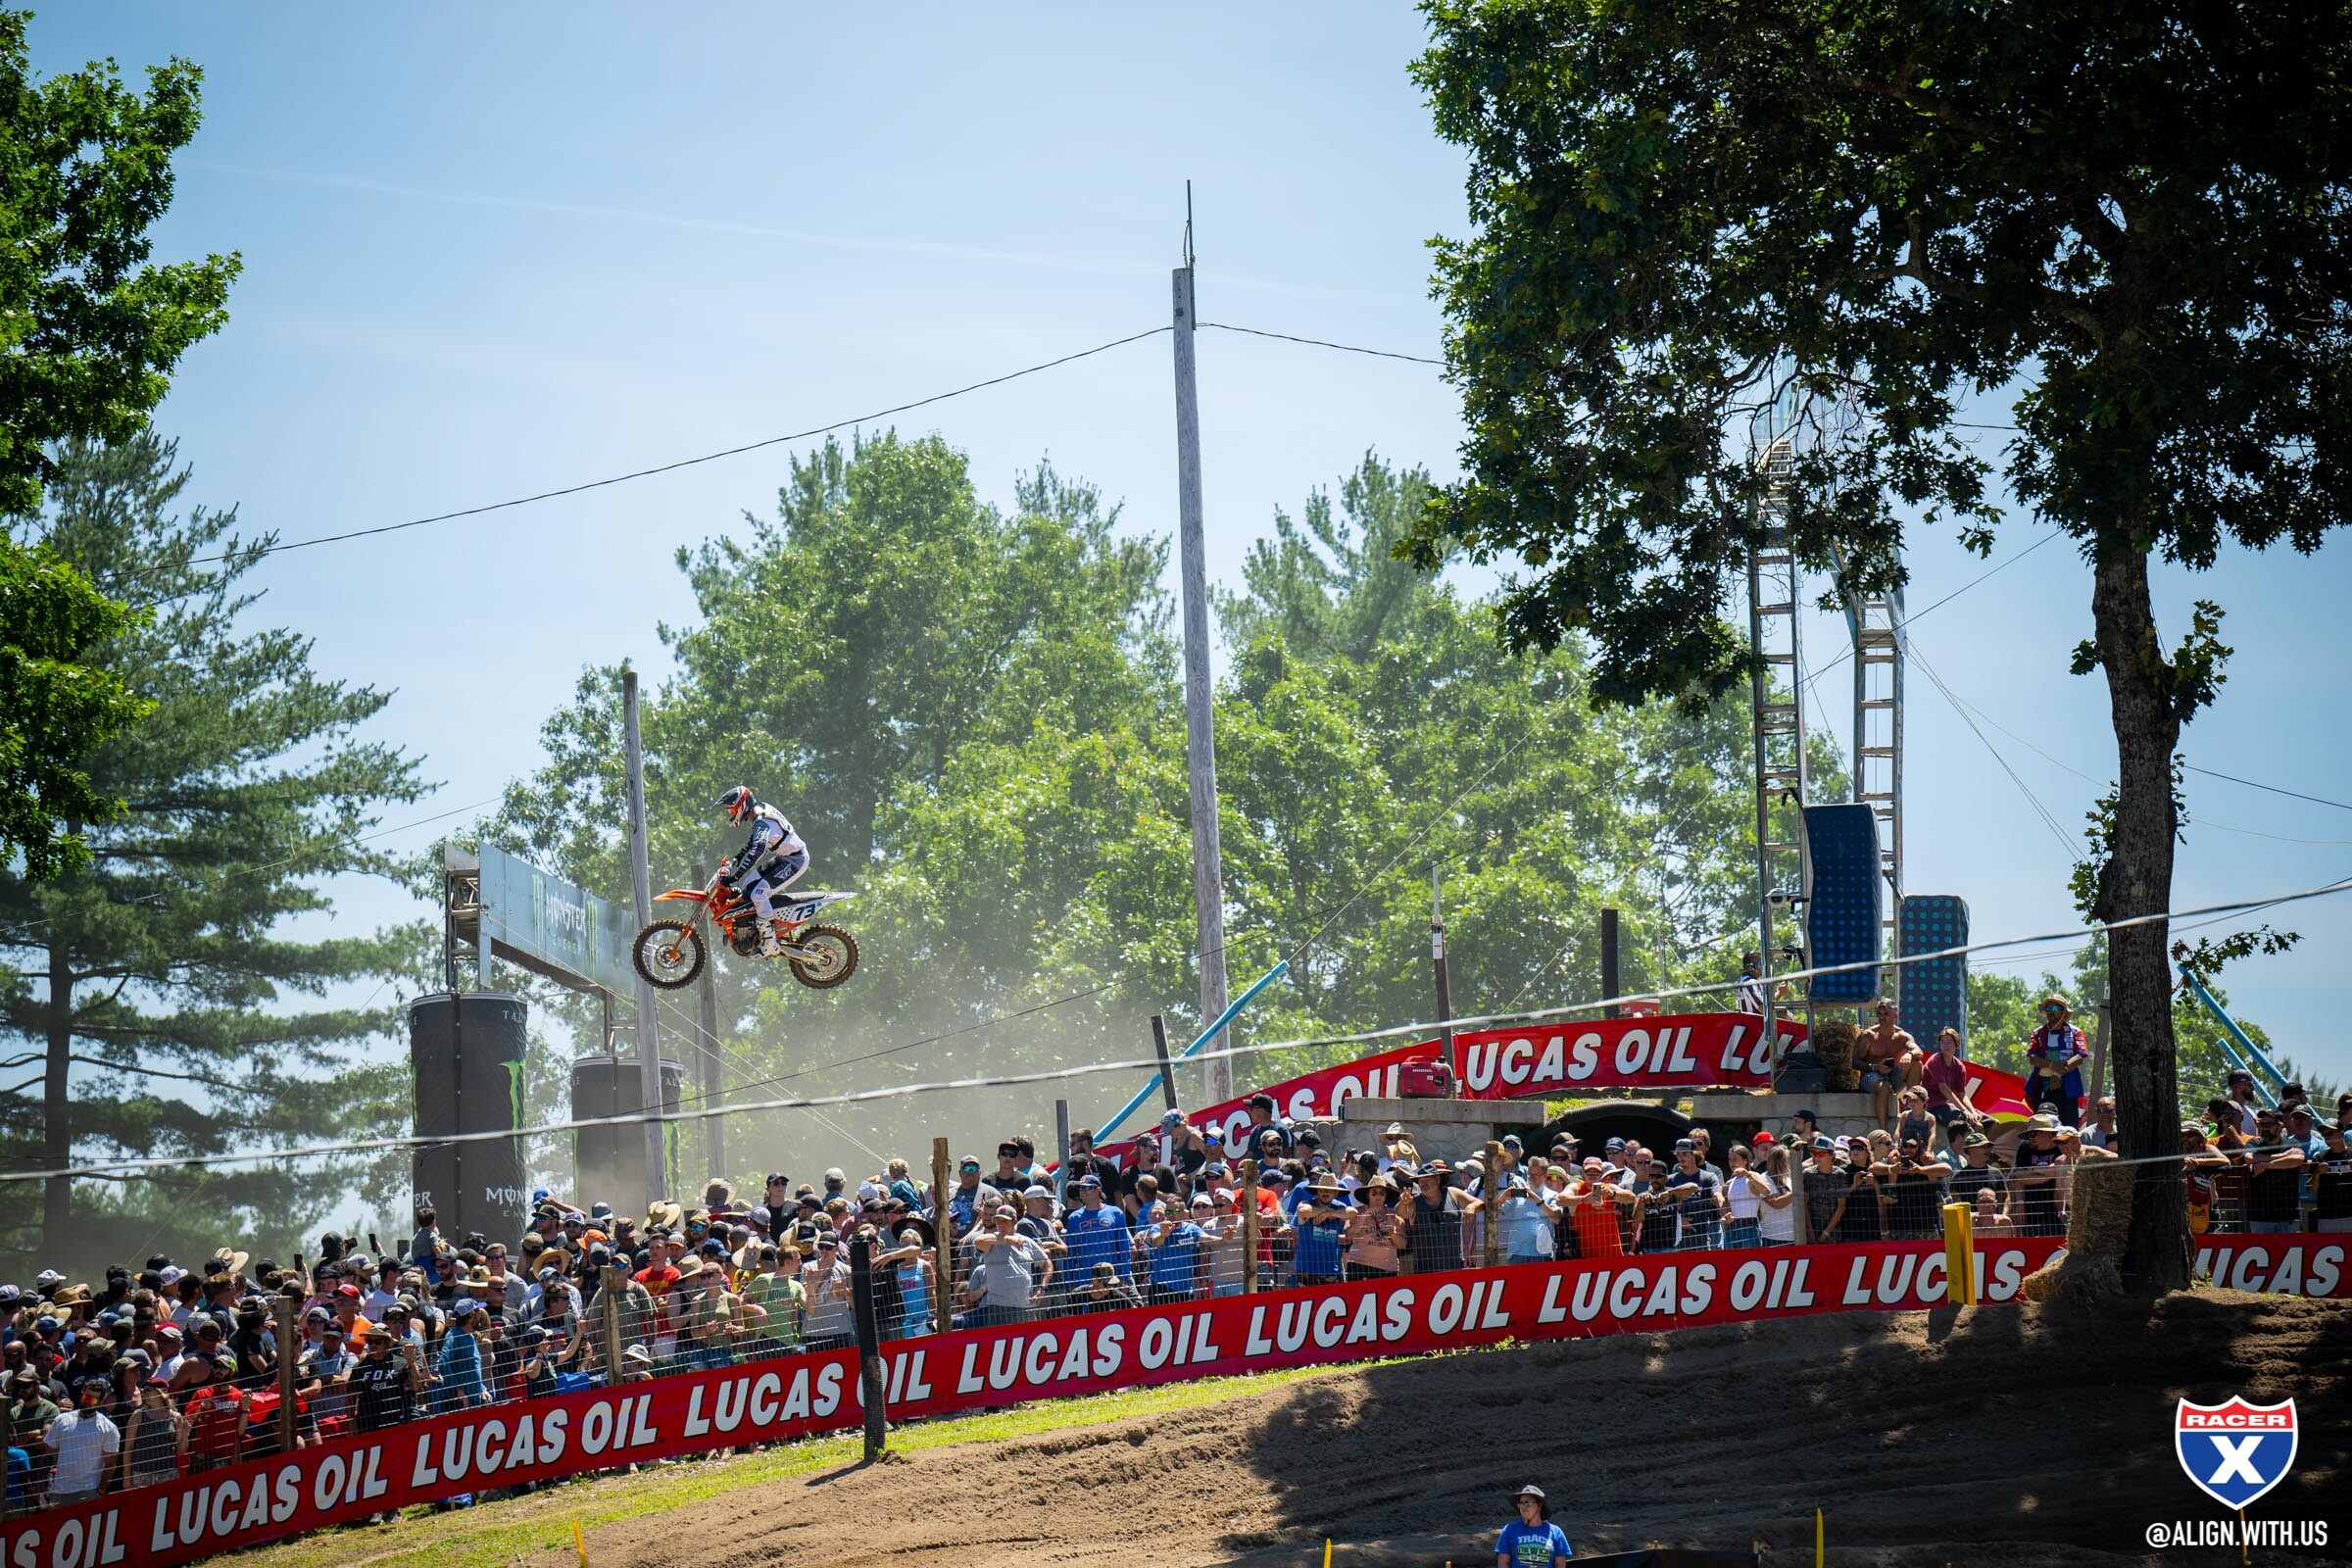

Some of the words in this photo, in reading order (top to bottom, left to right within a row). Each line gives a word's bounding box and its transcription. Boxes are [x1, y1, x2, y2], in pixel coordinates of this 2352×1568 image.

[545, 890, 588, 938] MONSTER
[794, 903, 816, 921] 73
[1457, 1032, 1602, 1092] UCAS
[1615, 1027, 1697, 1076] OIL
[1079, 1216, 1112, 1232] PFG
[1537, 1263, 1717, 1323] LUCAS
[1730, 1258, 1815, 1311] OIL
[2194, 1246, 2345, 1297] UCAS
[1245, 1288, 1415, 1356] LUCAS
[1428, 1279, 1510, 1335] OIL
[362, 1368, 396, 1383] FOX
[956, 1323, 1125, 1395] LUCAS
[1139, 1311, 1219, 1370] OIL
[683, 1362, 844, 1438] LUCAS
[411, 1408, 568, 1488] LUCAS
[581, 1394, 658, 1454] OIL
[151, 1464, 301, 1551] LUCAS
[314, 1445, 388, 1510] OIL
[52, 1509, 125, 1568] OIL
